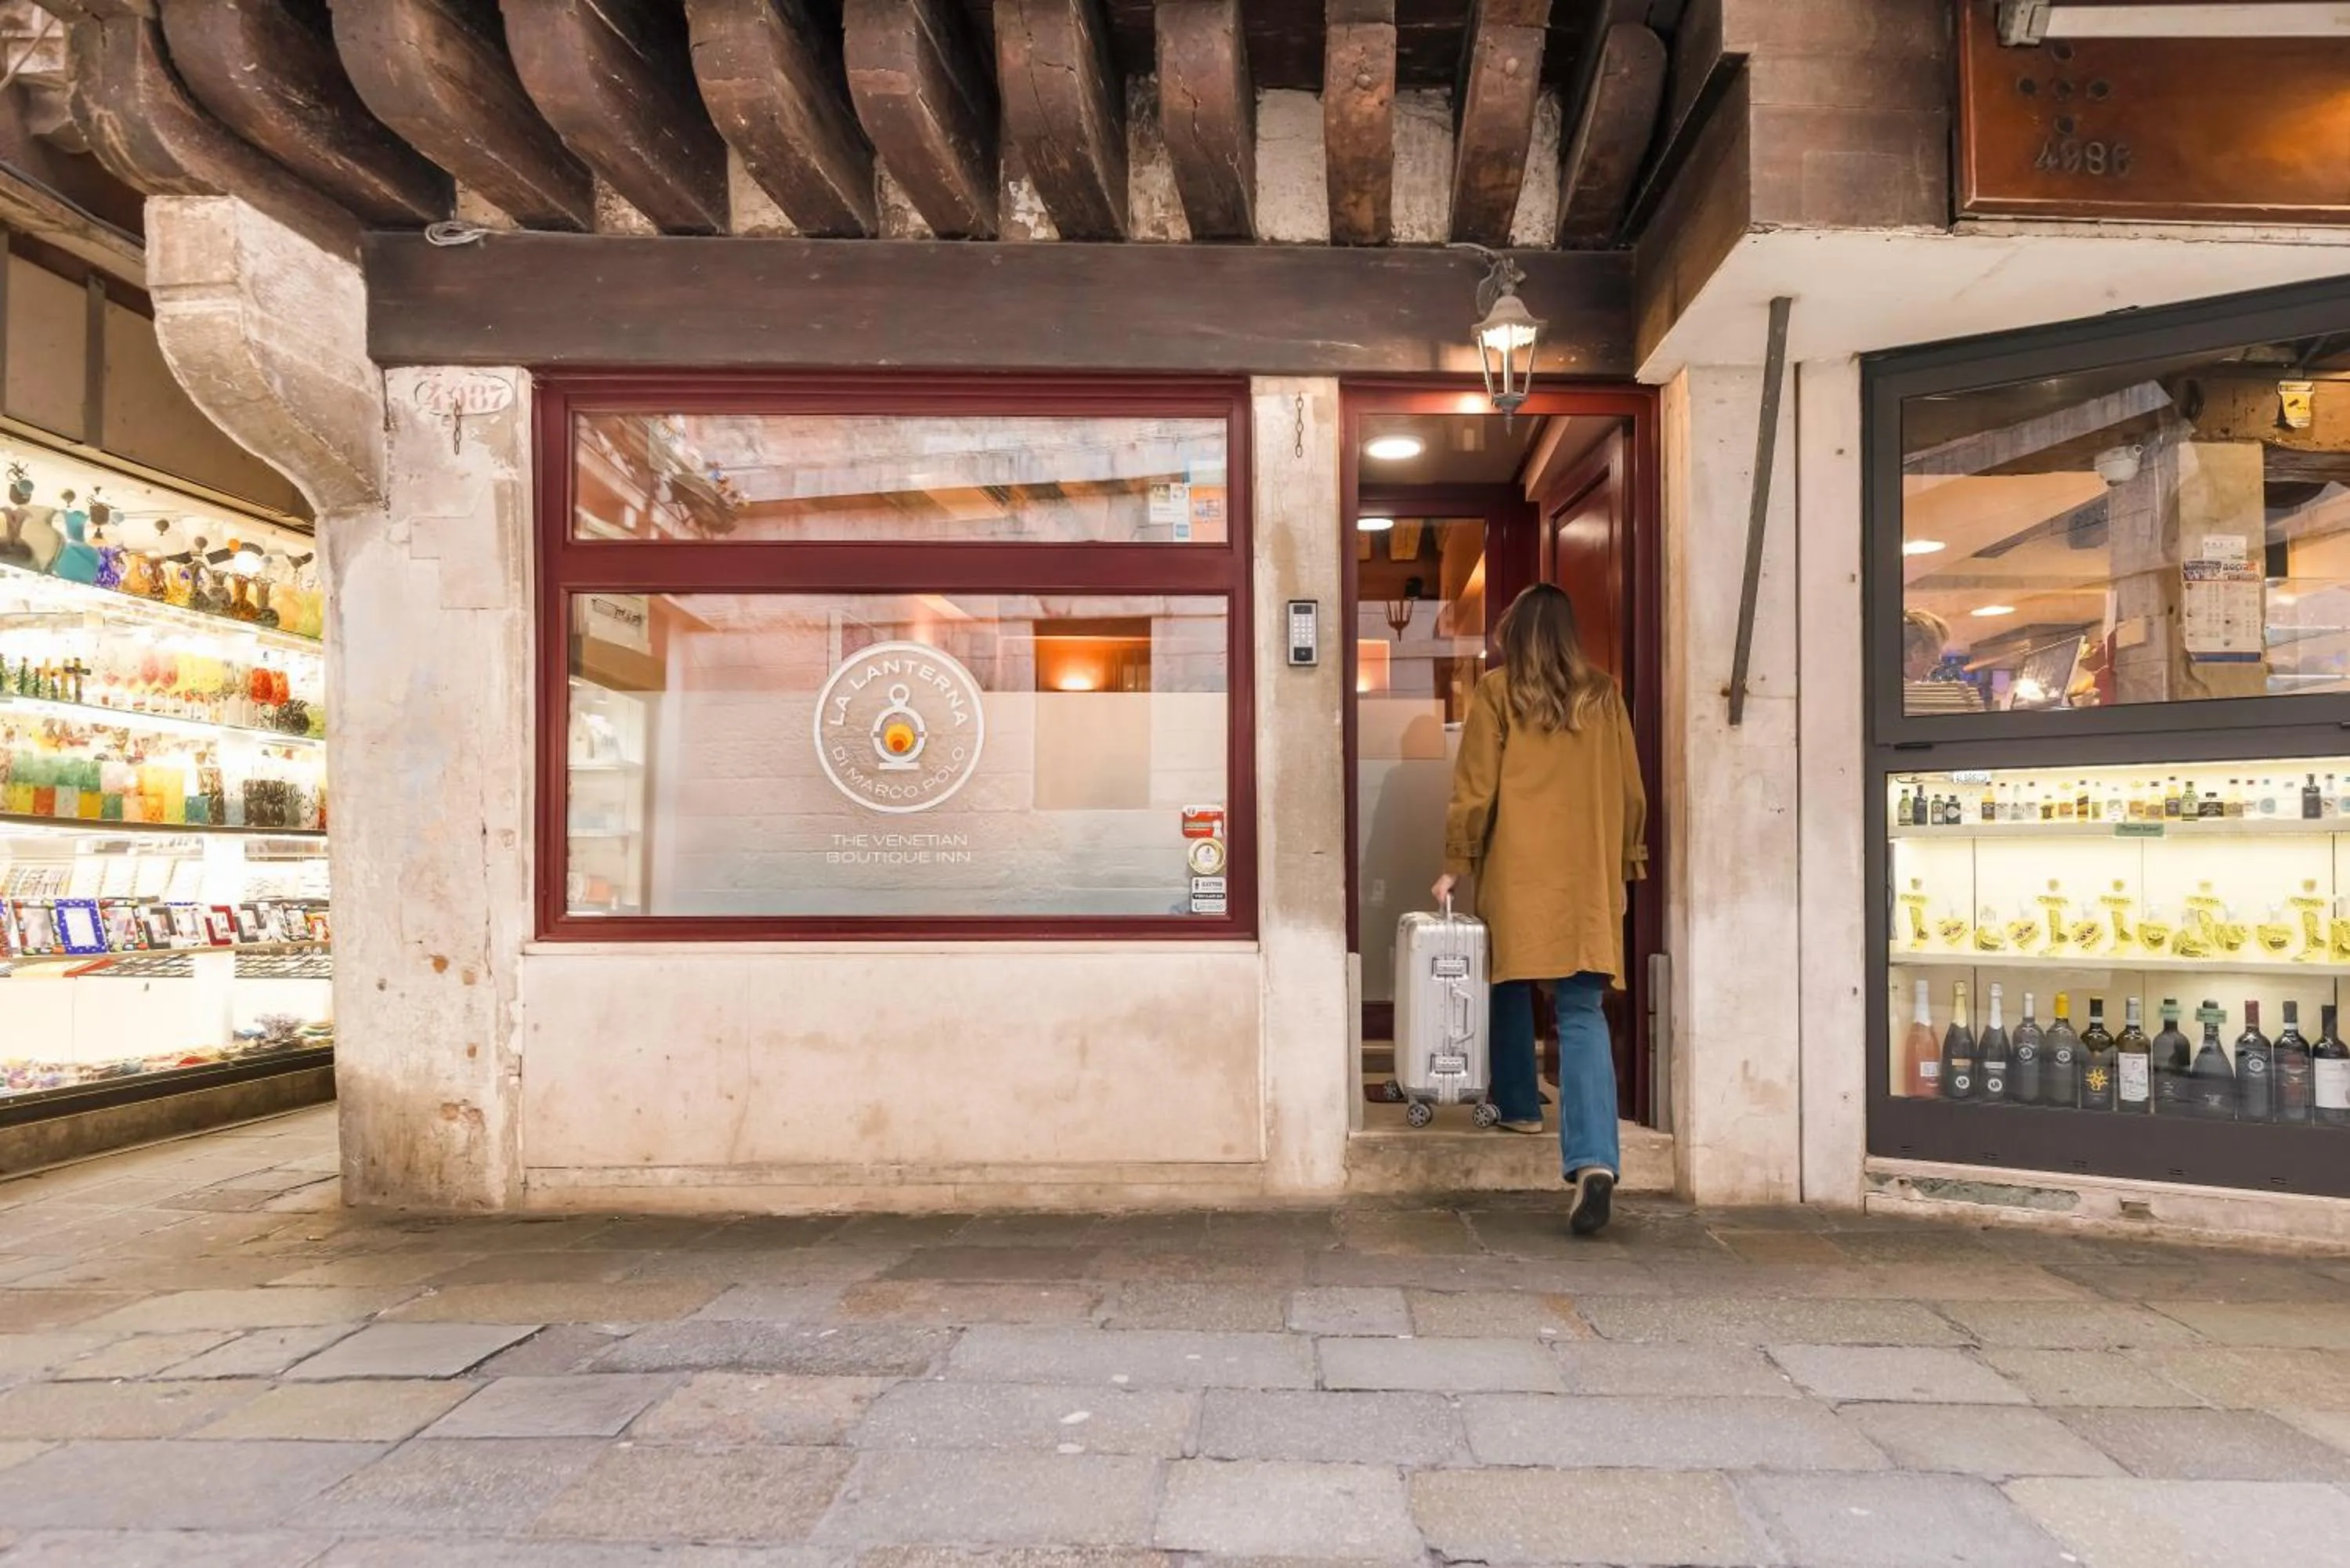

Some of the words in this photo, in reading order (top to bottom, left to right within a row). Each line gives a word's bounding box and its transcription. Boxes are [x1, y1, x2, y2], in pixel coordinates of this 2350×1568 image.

[829, 694, 851, 727] LA
[851, 660, 967, 726] LANTERNA
[832, 745, 848, 768] DI
[847, 766, 917, 800] MARCO
[923, 746, 966, 792] POLO
[826, 851, 932, 865] BOUTIQUE
[935, 851, 972, 864] INN
[832, 833, 869, 848] THE
[872, 833, 968, 848] VENETIAN
